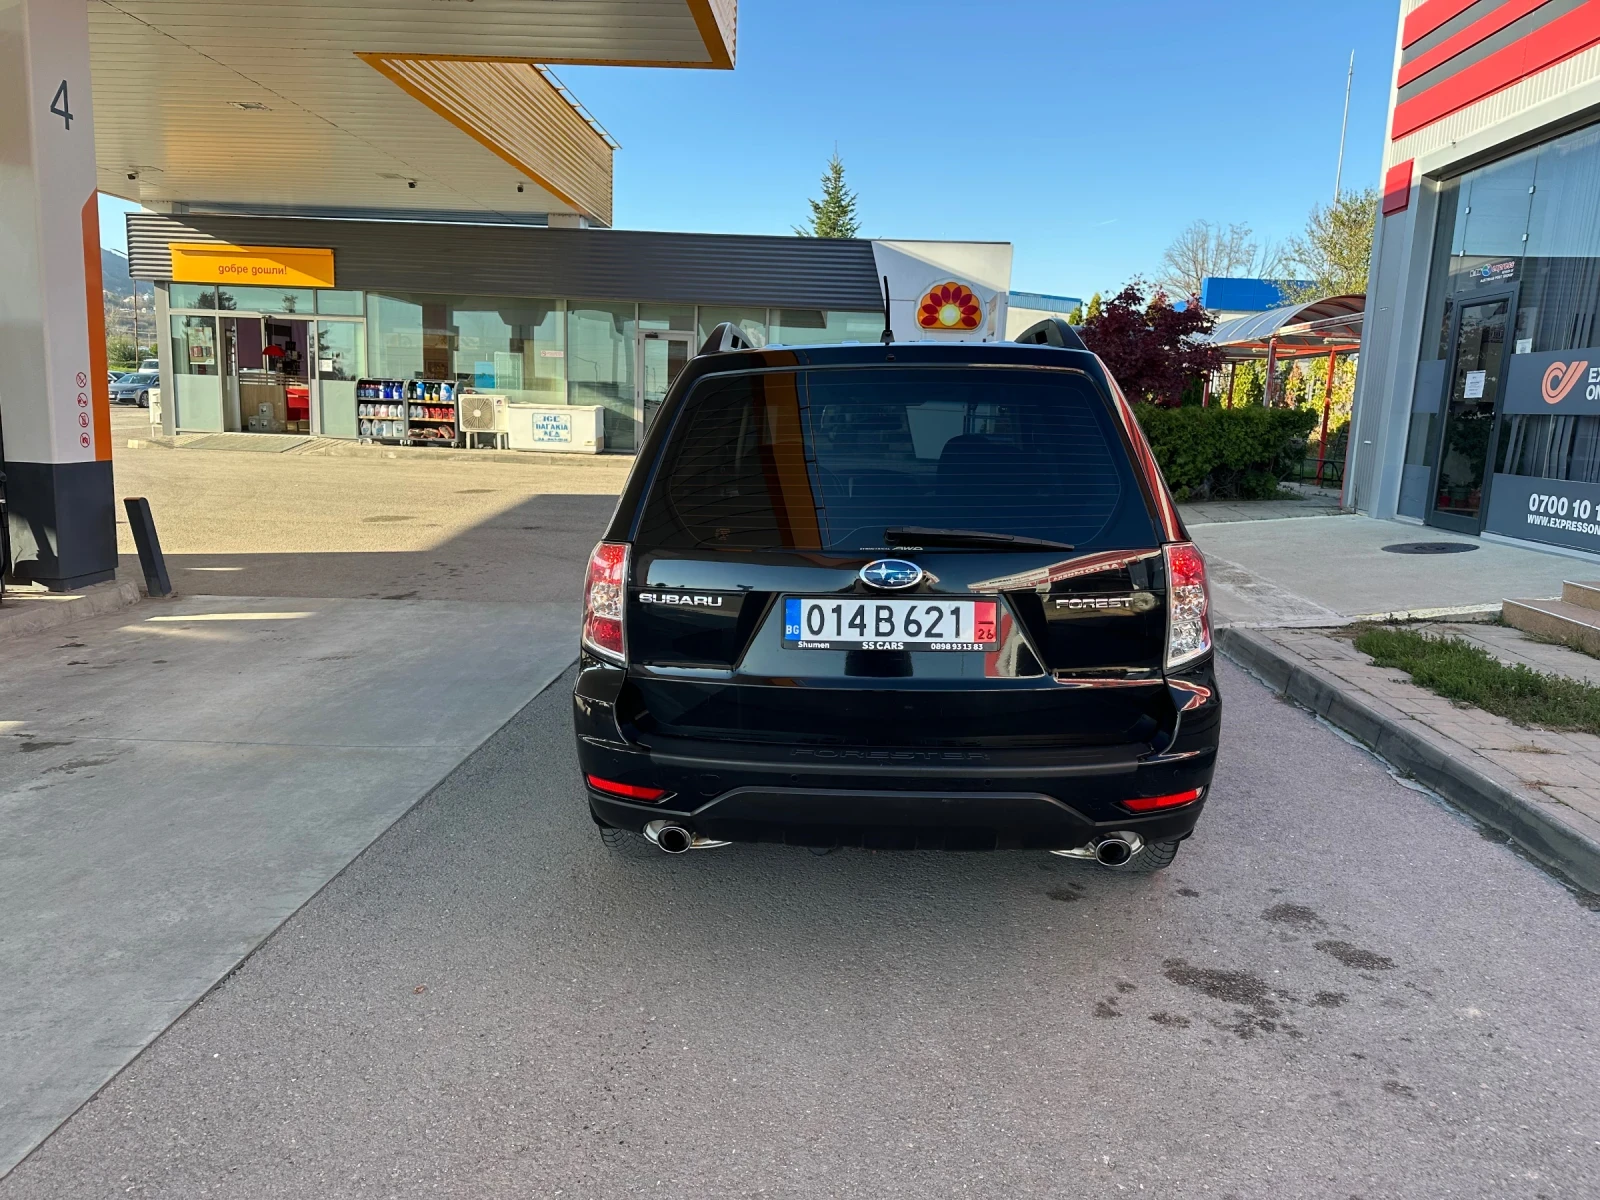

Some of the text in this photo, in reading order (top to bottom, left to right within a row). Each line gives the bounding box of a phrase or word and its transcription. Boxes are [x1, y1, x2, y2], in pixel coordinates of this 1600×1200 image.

[50, 79, 74, 131] 4
[218, 264, 287, 276] добре дошли!
[1529, 493, 1568, 516] 0700
[1572, 499, 1591, 519] 10
[638, 592, 723, 606] SUBARU
[786, 625, 800, 635] BG
[797, 641, 830, 649] Shumen
[862, 641, 904, 650] SS CARS
[973, 643, 983, 651] 83
[789, 748, 991, 761] FORESTER
